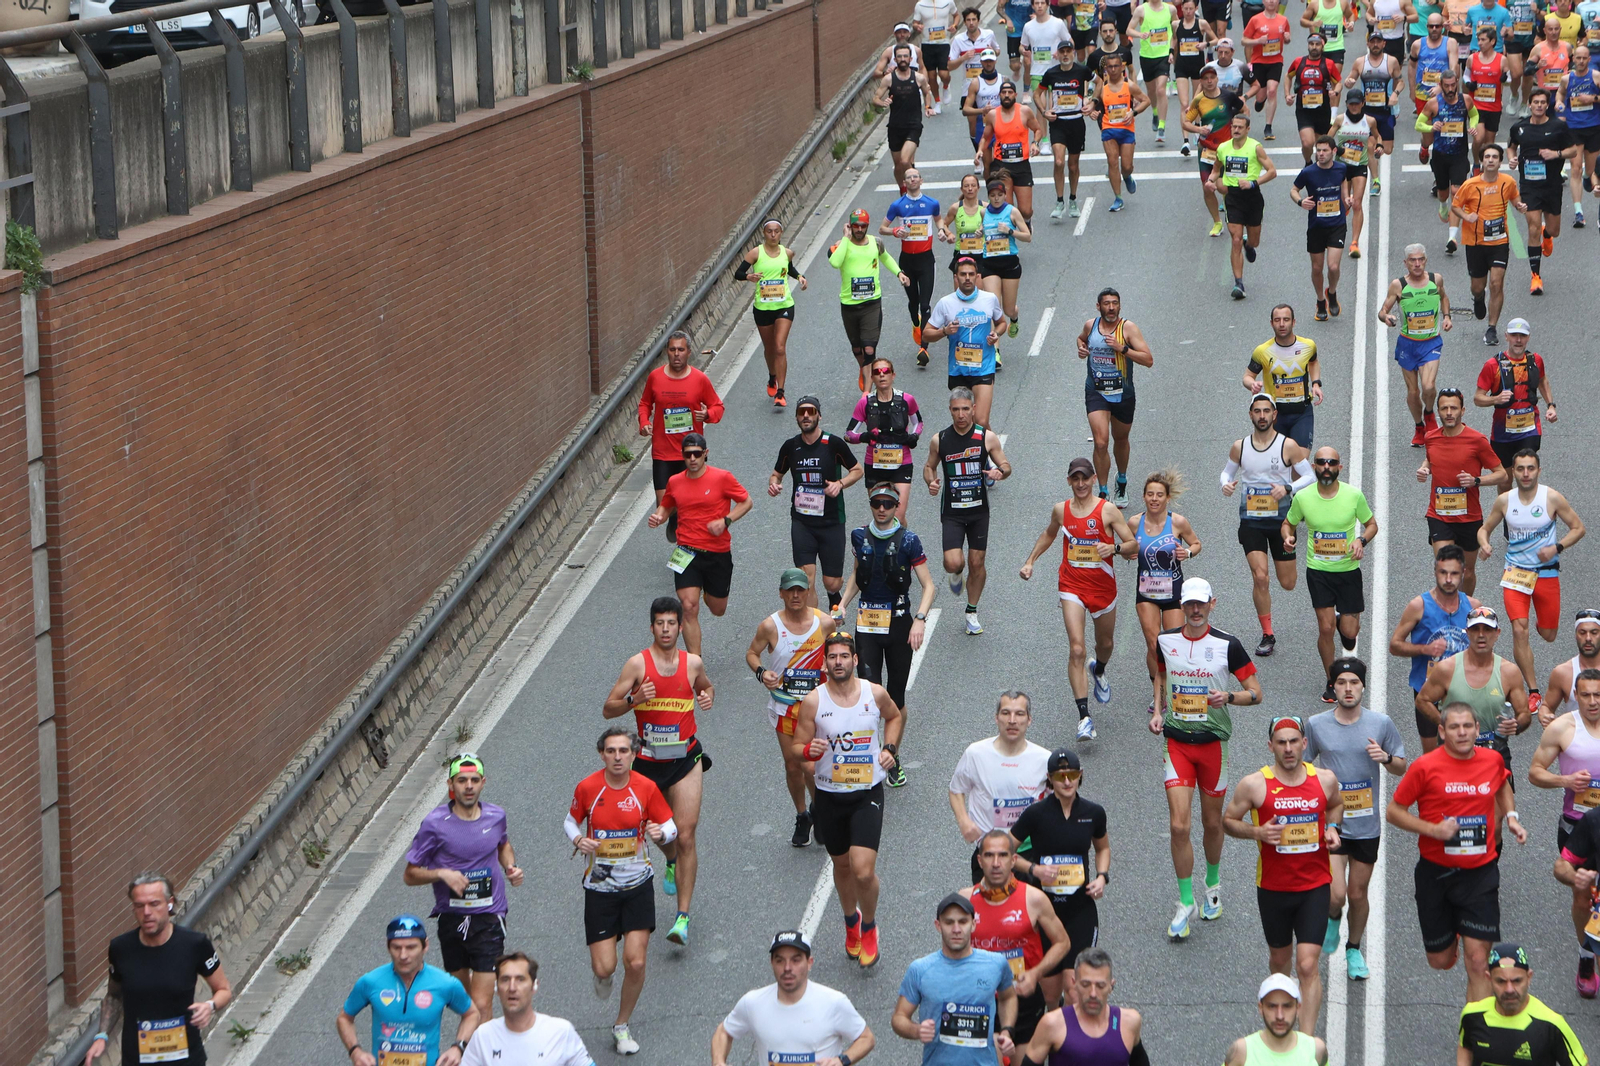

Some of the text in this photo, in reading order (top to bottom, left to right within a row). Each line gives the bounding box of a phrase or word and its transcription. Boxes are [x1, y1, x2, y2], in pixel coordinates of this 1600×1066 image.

[161, 20, 180, 32] LSS
[1091, 356, 1114, 364] SISVIAL
[803, 458, 821, 467] MET
[1170, 667, 1214, 678] maratón
[645, 701, 685, 710] Carnethy
[653, 726, 676, 734] ZURICH
[1344, 782, 1368, 790] ZURICH
[1445, 786, 1477, 794] OZONO
[1007, 799, 1031, 807] ZURICH
[1274, 800, 1309, 809] OZONO
[1290, 815, 1315, 823] ZURICH
[1459, 817, 1484, 826] ZURICH
[608, 830, 633, 838] ZURICH
[1289, 828, 1305, 836] 4755
[608, 842, 624, 850] 3670
[464, 870, 488, 879] ZURICH
[466, 884, 480, 892] 203
[1461, 919, 1497, 933] ARMOUR
[960, 1004, 986, 1014] ZURICH
[153, 1020, 180, 1030] ZURICH
[956, 1018, 974, 1028] 3313
[393, 1043, 422, 1053] ZURICH
[782, 1054, 810, 1063] ZURICH
